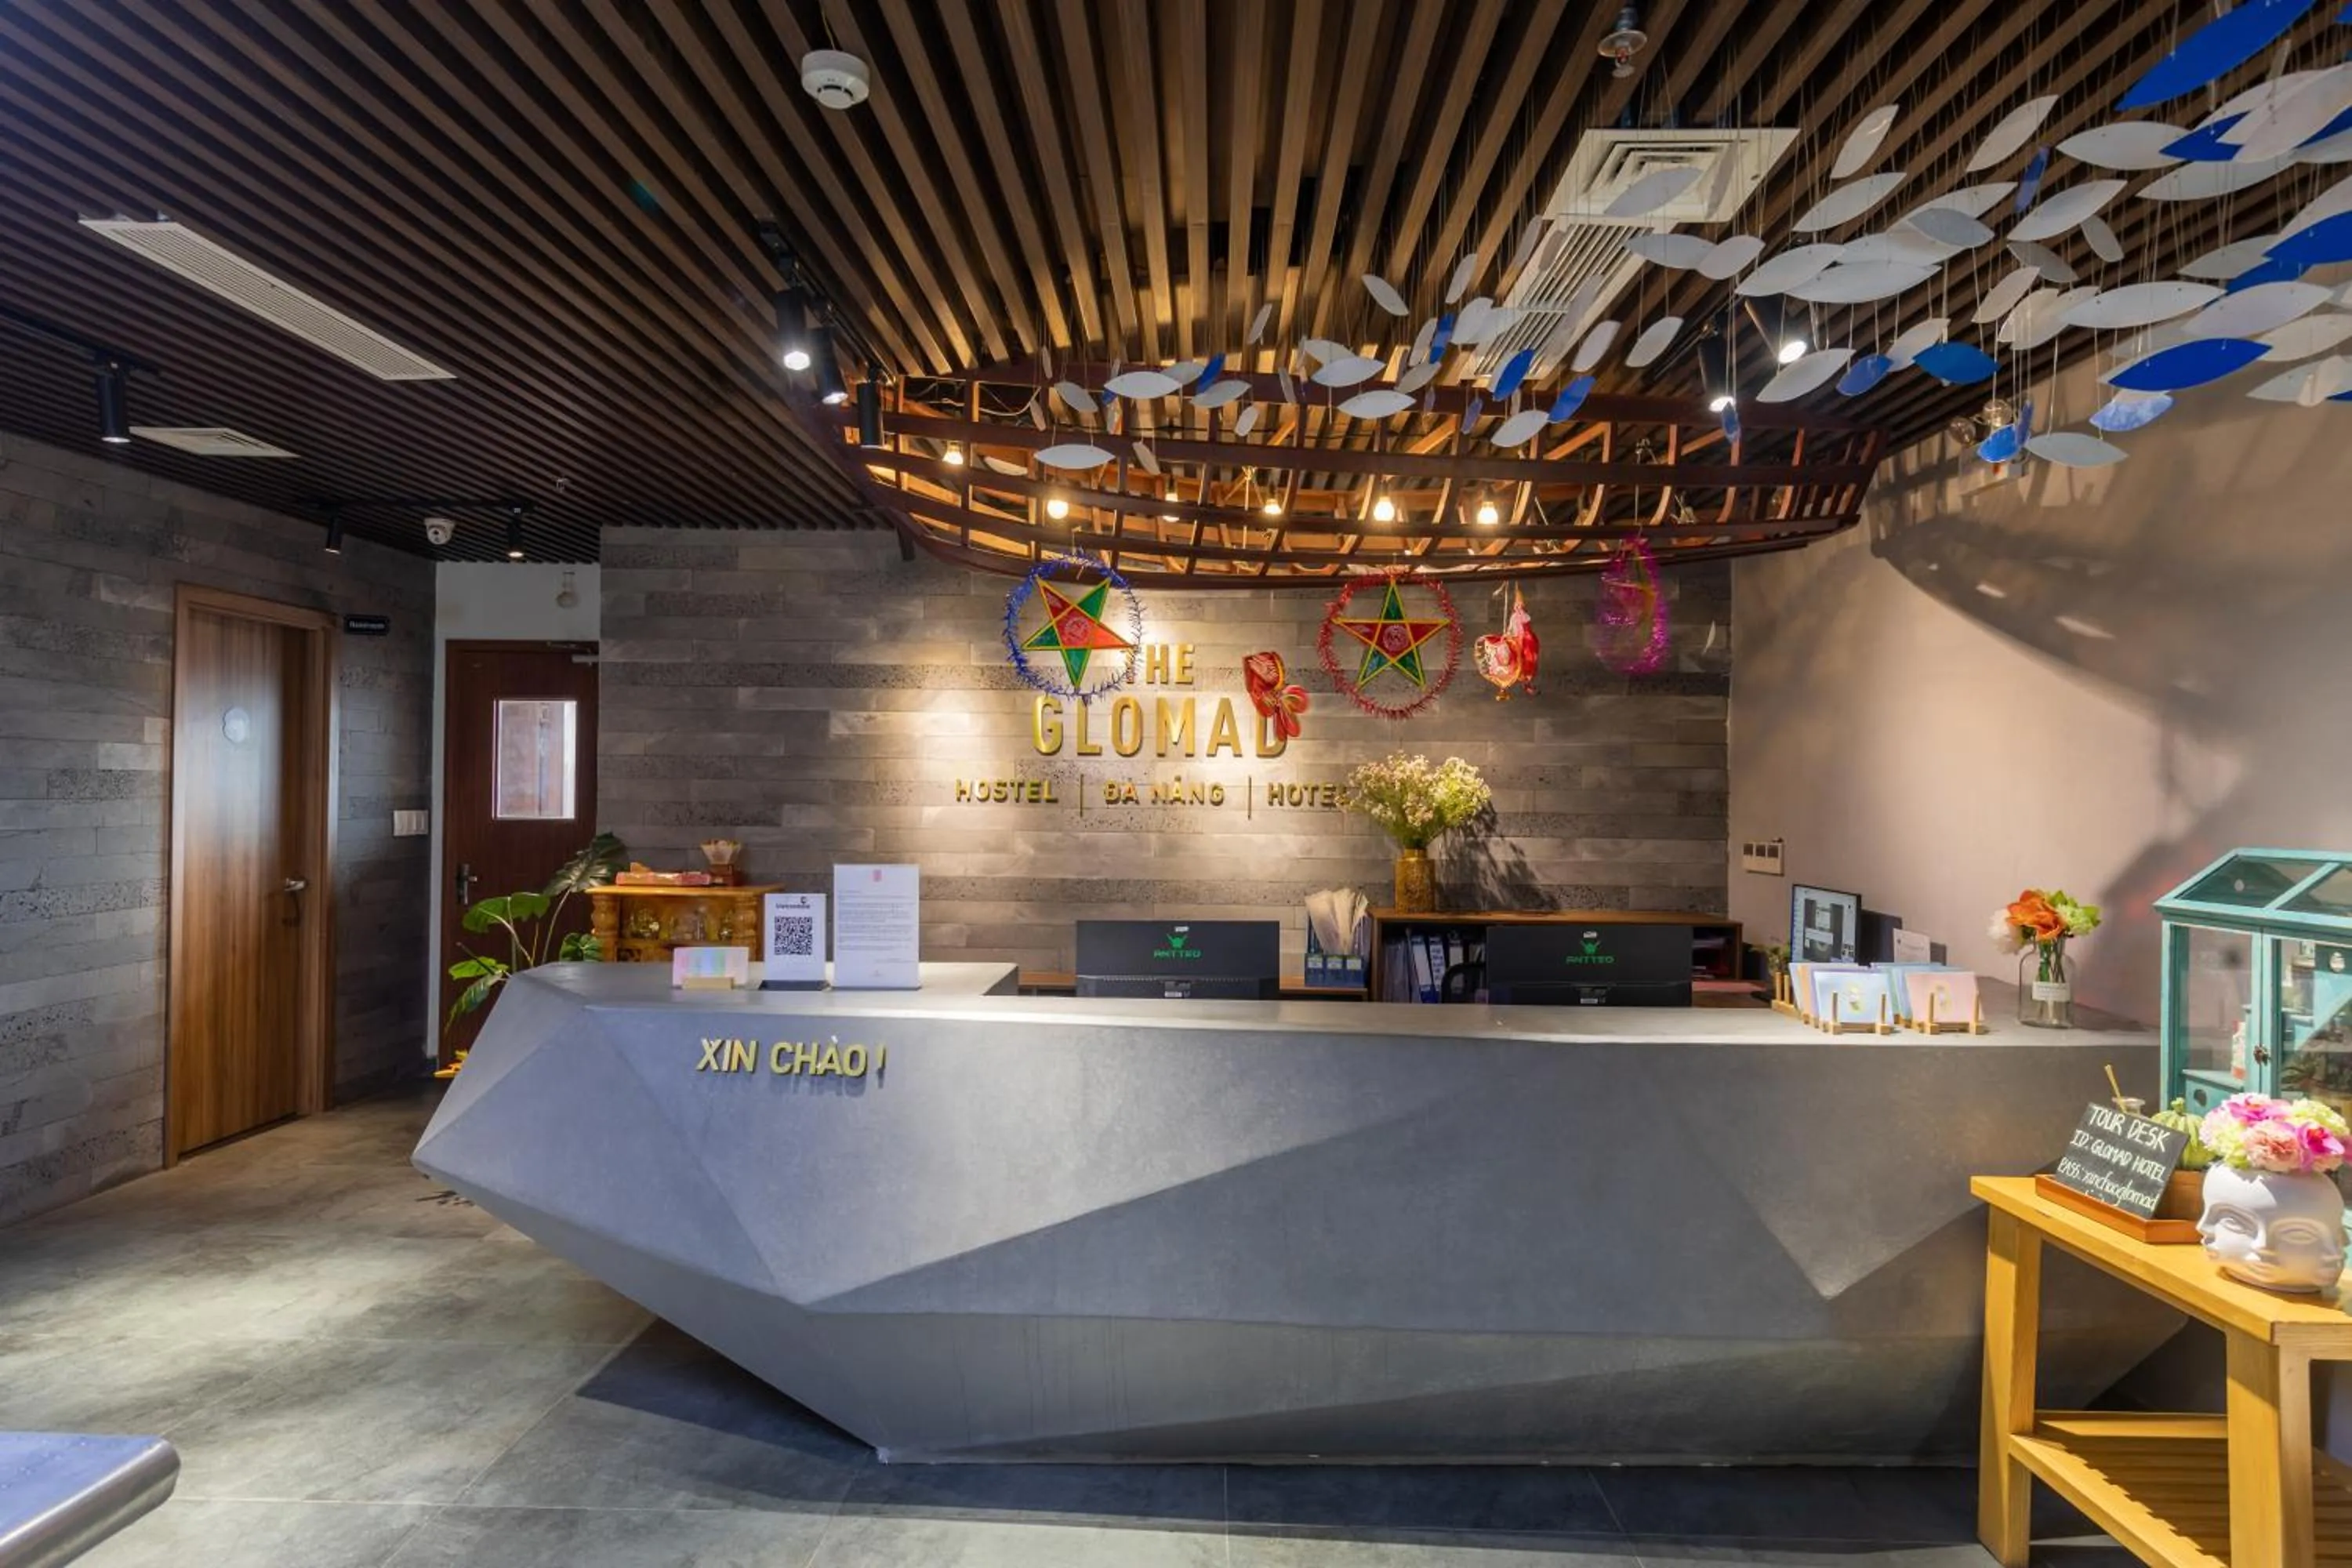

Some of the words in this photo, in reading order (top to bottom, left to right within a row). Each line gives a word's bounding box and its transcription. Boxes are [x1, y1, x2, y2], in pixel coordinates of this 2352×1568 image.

[1032, 695, 1287, 757] GLOMAD
[955, 779, 1058, 803] HOSTEL
[695, 1037, 758, 1073] XIN
[769, 1035, 868, 1078] CHÀO
[2089, 1105, 2125, 1136] TOUR
[2127, 1119, 2171, 1152] DESK
[2070, 1129, 2093, 1150] ID:
[2090, 1139, 2132, 1167] GLOMAD
[2132, 1155, 2166, 1183] HOTEL
